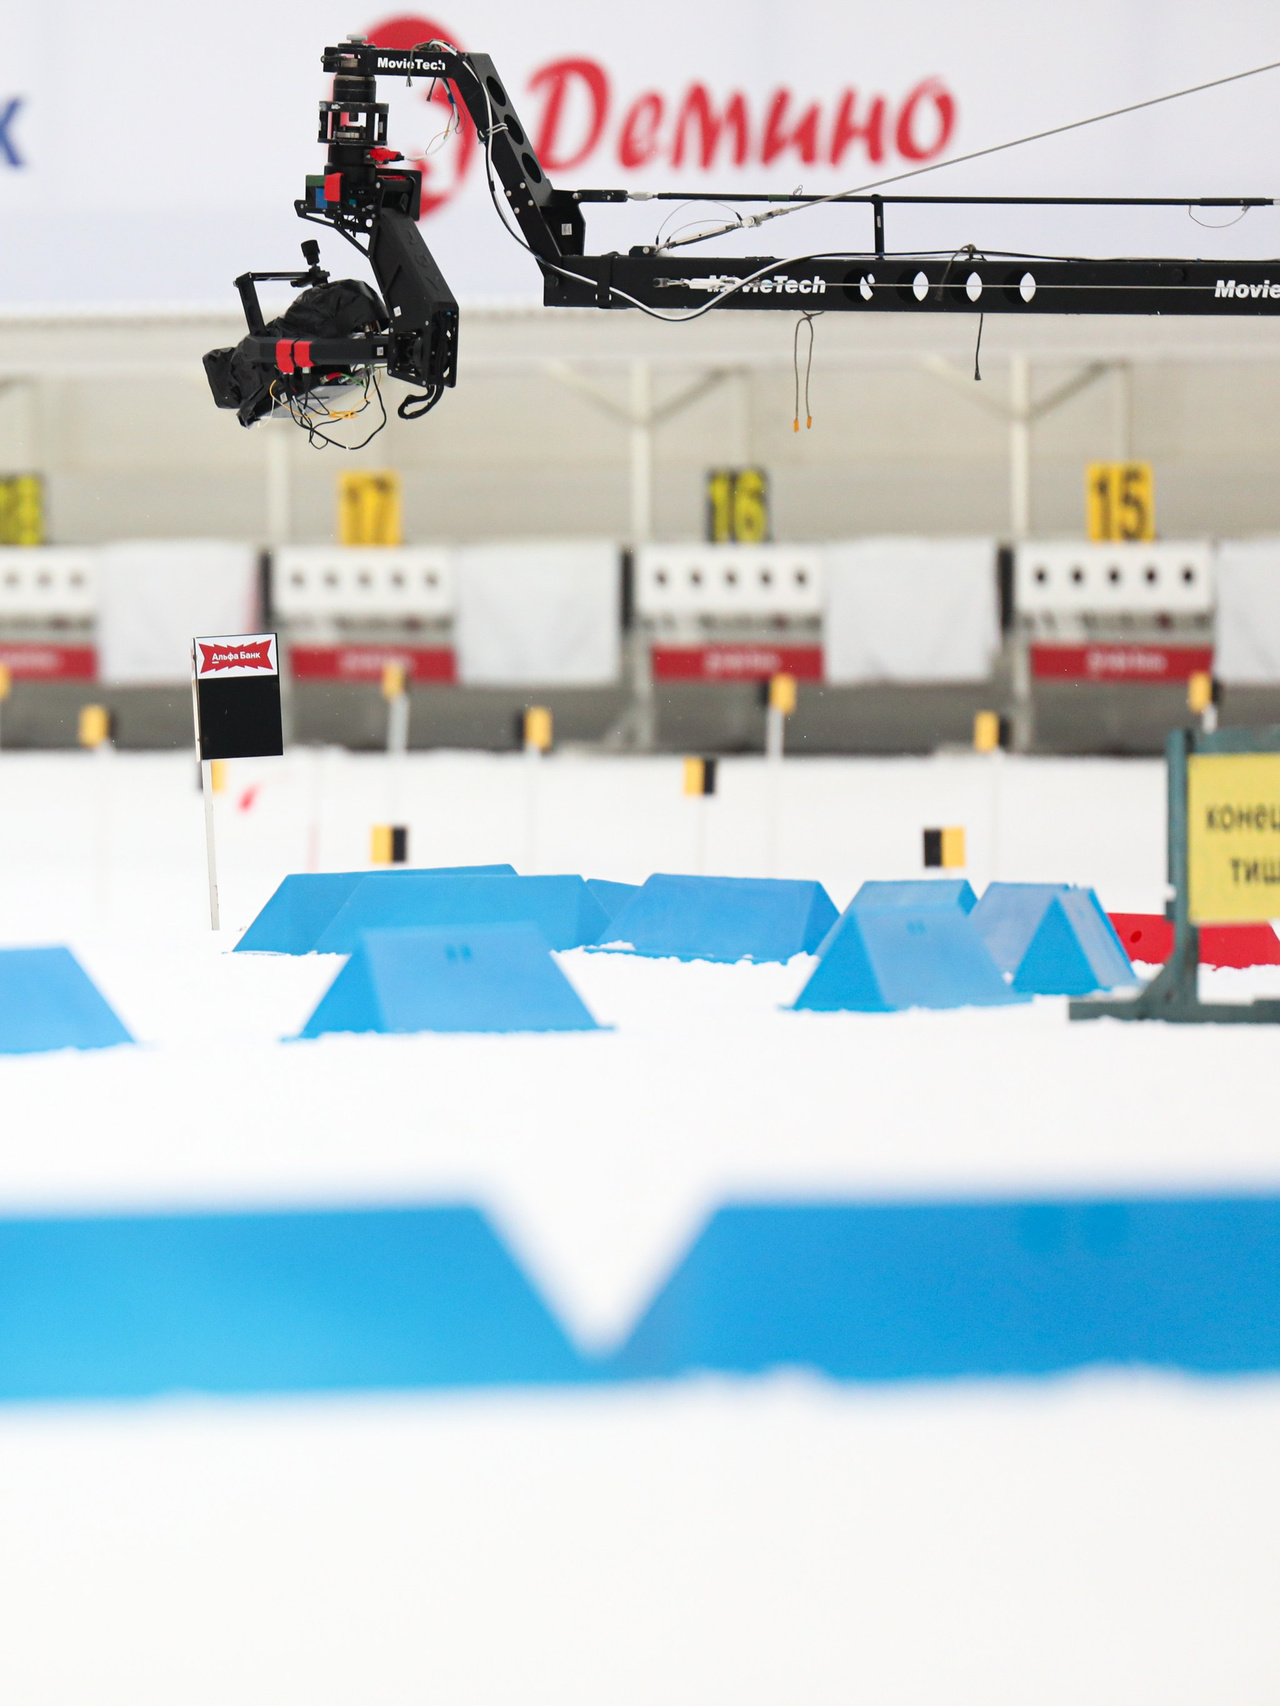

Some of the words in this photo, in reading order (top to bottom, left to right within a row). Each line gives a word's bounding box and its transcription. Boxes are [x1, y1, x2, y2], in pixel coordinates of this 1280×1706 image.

[377, 57, 446, 71] MovieTech
[527, 56, 957, 173] Демино
[709, 469, 765, 544] 16
[1092, 465, 1147, 541] 15
[212, 652, 239, 664] Альфа
[240, 651, 261, 659] Банк
